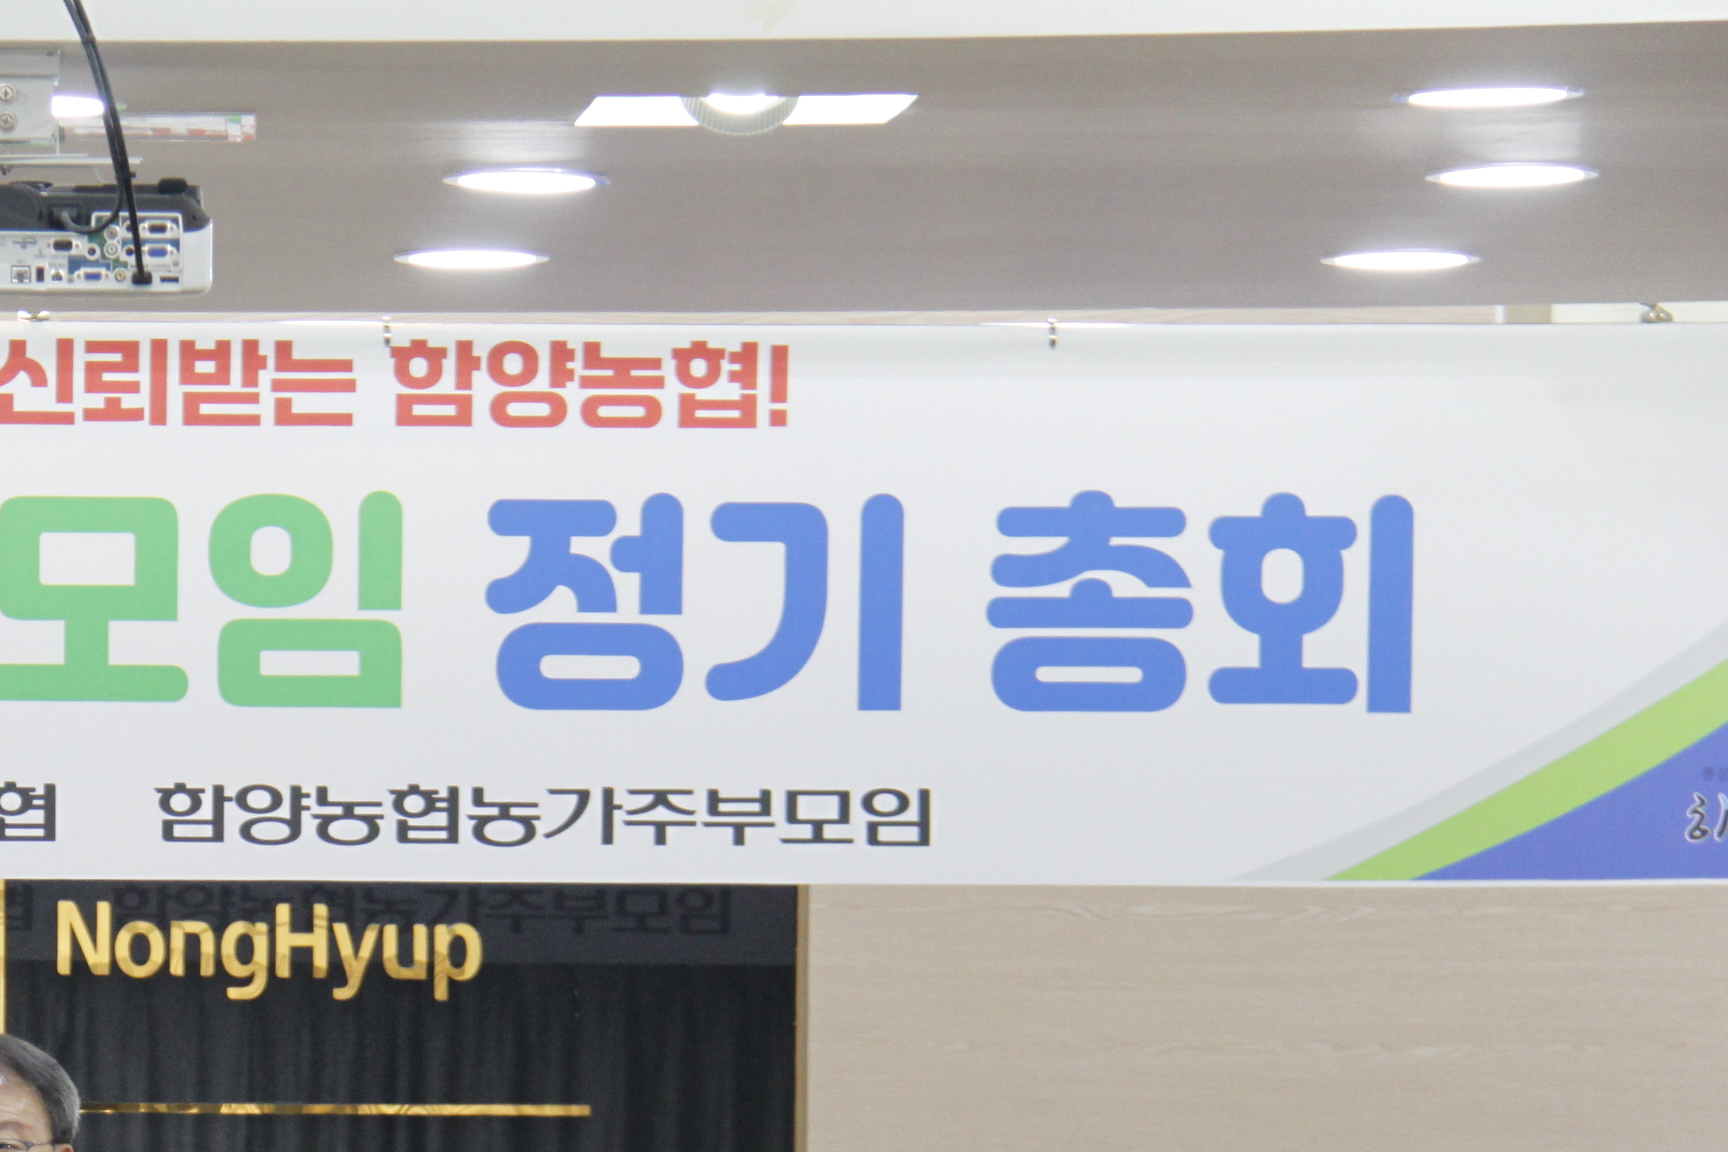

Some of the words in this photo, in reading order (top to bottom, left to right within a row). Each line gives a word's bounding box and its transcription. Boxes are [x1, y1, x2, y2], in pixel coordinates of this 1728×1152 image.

[390, 339, 790, 430] 함양농협!
[484, 492, 905, 712] 정기
[986, 489, 1415, 714] 총회
[154, 781, 931, 848] 함양농협농가주부모임
[56, 899, 484, 1002] NongHyup
